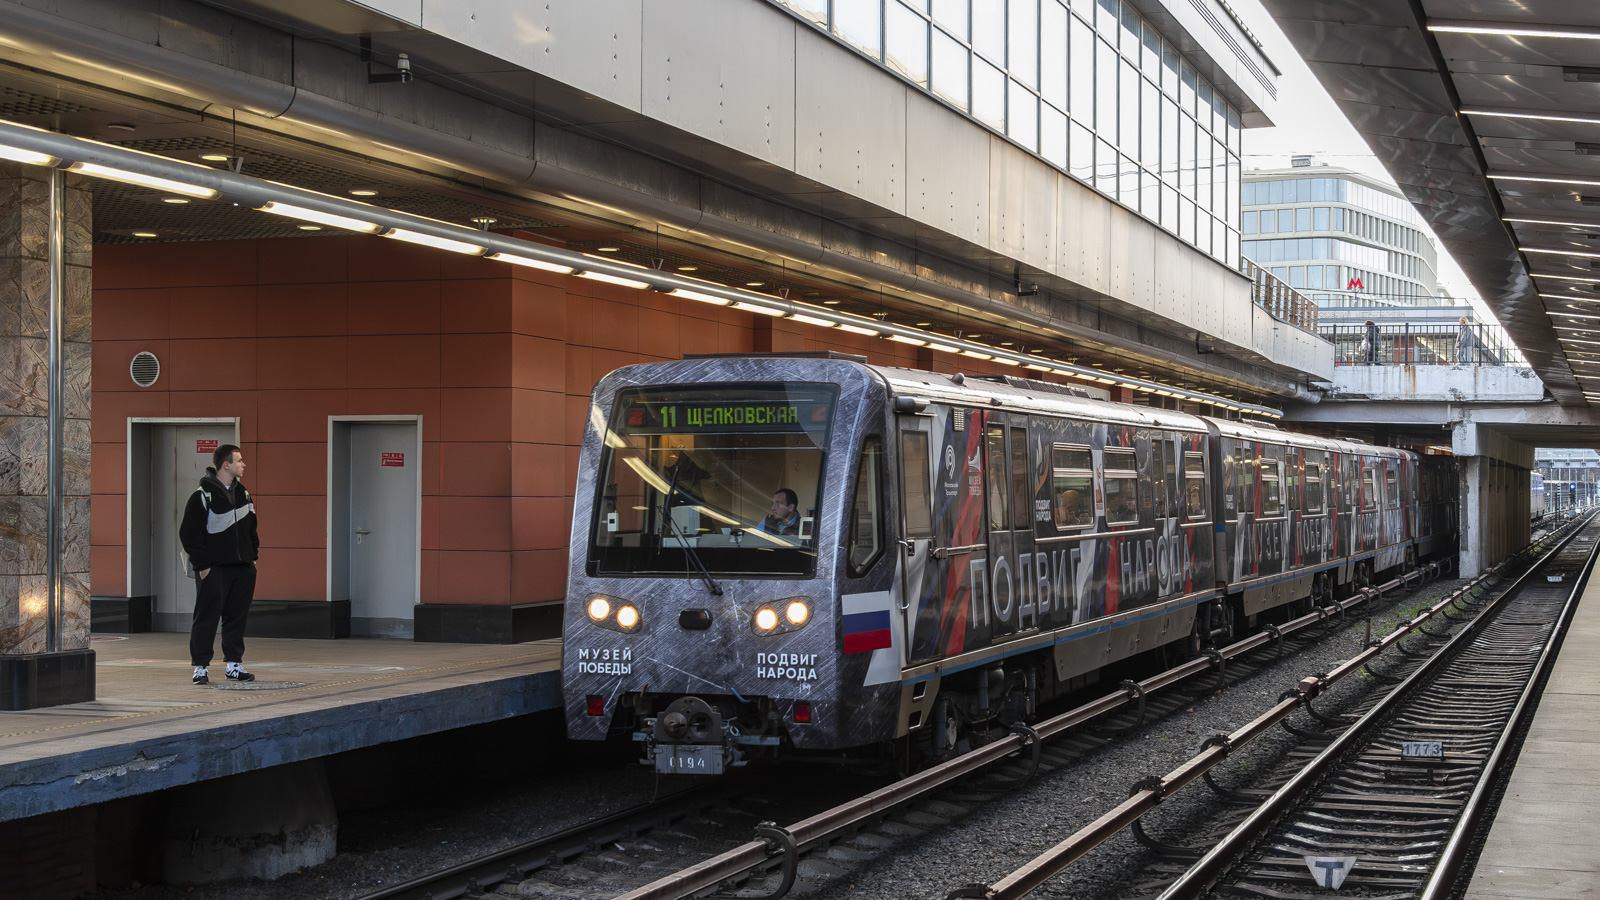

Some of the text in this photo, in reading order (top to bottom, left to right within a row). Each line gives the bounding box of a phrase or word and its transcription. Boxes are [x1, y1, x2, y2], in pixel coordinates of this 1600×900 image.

[660, 405, 798, 428] 11 ЩЕЛКОВСКАЯ
[969, 533, 1192, 630] ПОДВИГ НАРОДА
[578, 647, 633, 661] МУЗЕЙ
[757, 652, 818, 667] ПОДВИГ
[578, 662, 632, 676] ПОБЕДЫ
[757, 667, 818, 681] НАРОДА
[1404, 743, 1440, 755] 1773
[669, 756, 705, 769] 0194
